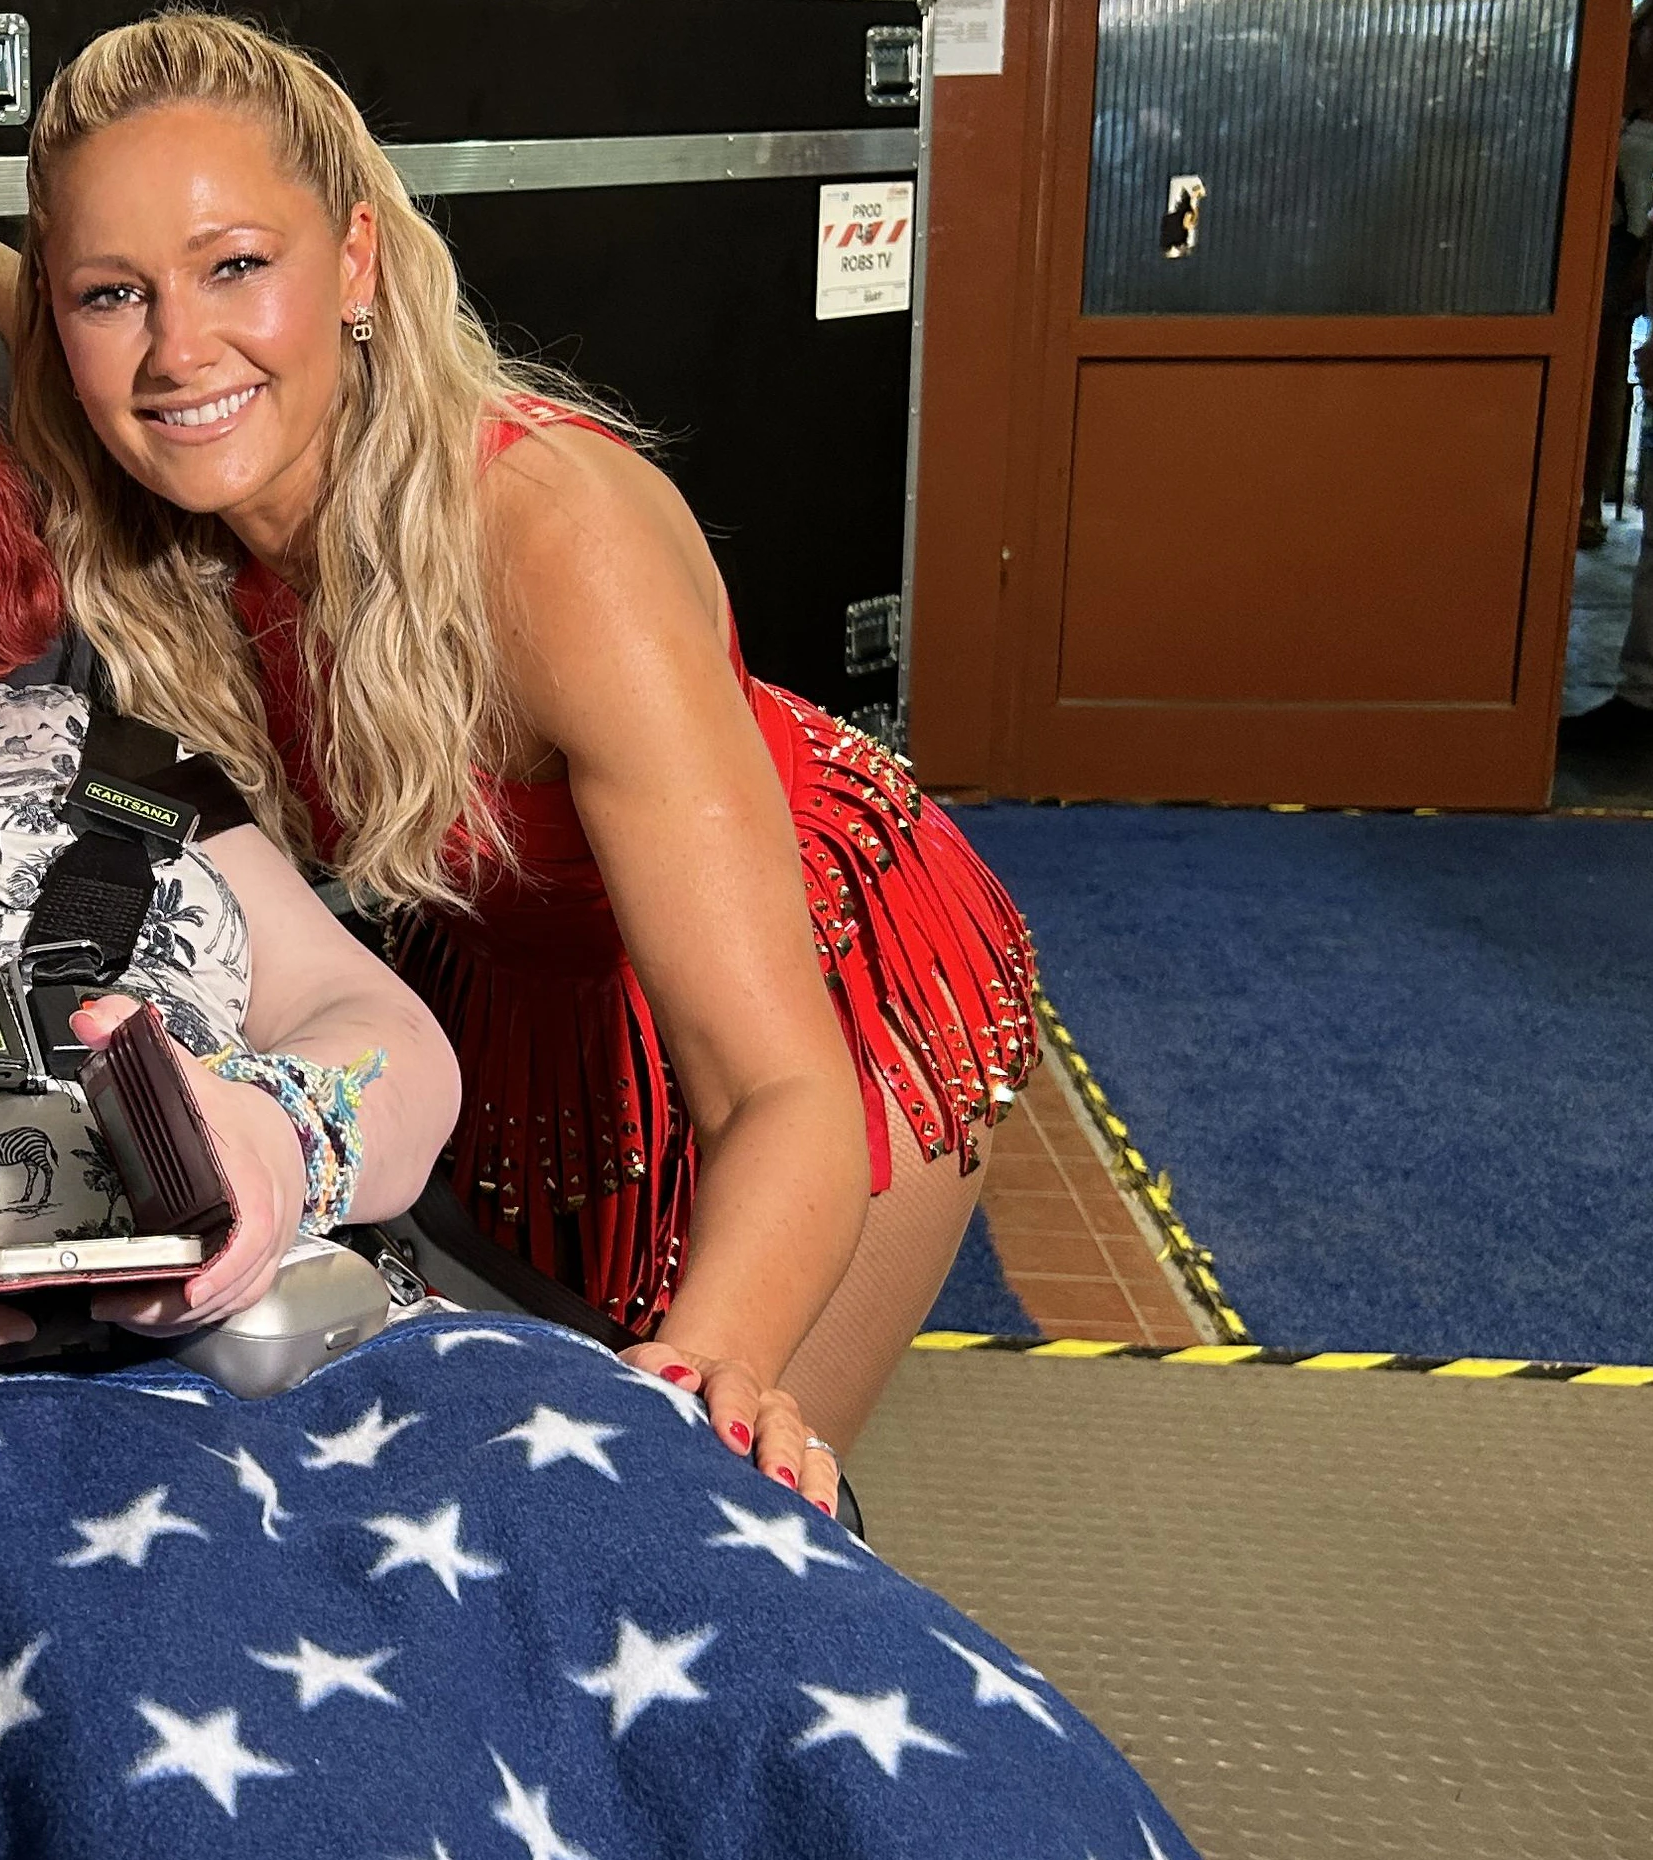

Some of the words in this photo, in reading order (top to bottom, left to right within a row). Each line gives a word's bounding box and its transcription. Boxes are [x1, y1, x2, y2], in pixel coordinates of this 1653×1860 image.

[852, 203, 882, 218] PROD
[841, 253, 874, 273] ROBS
[877, 251, 893, 269] TV
[90, 786, 171, 823] KARTSANA
